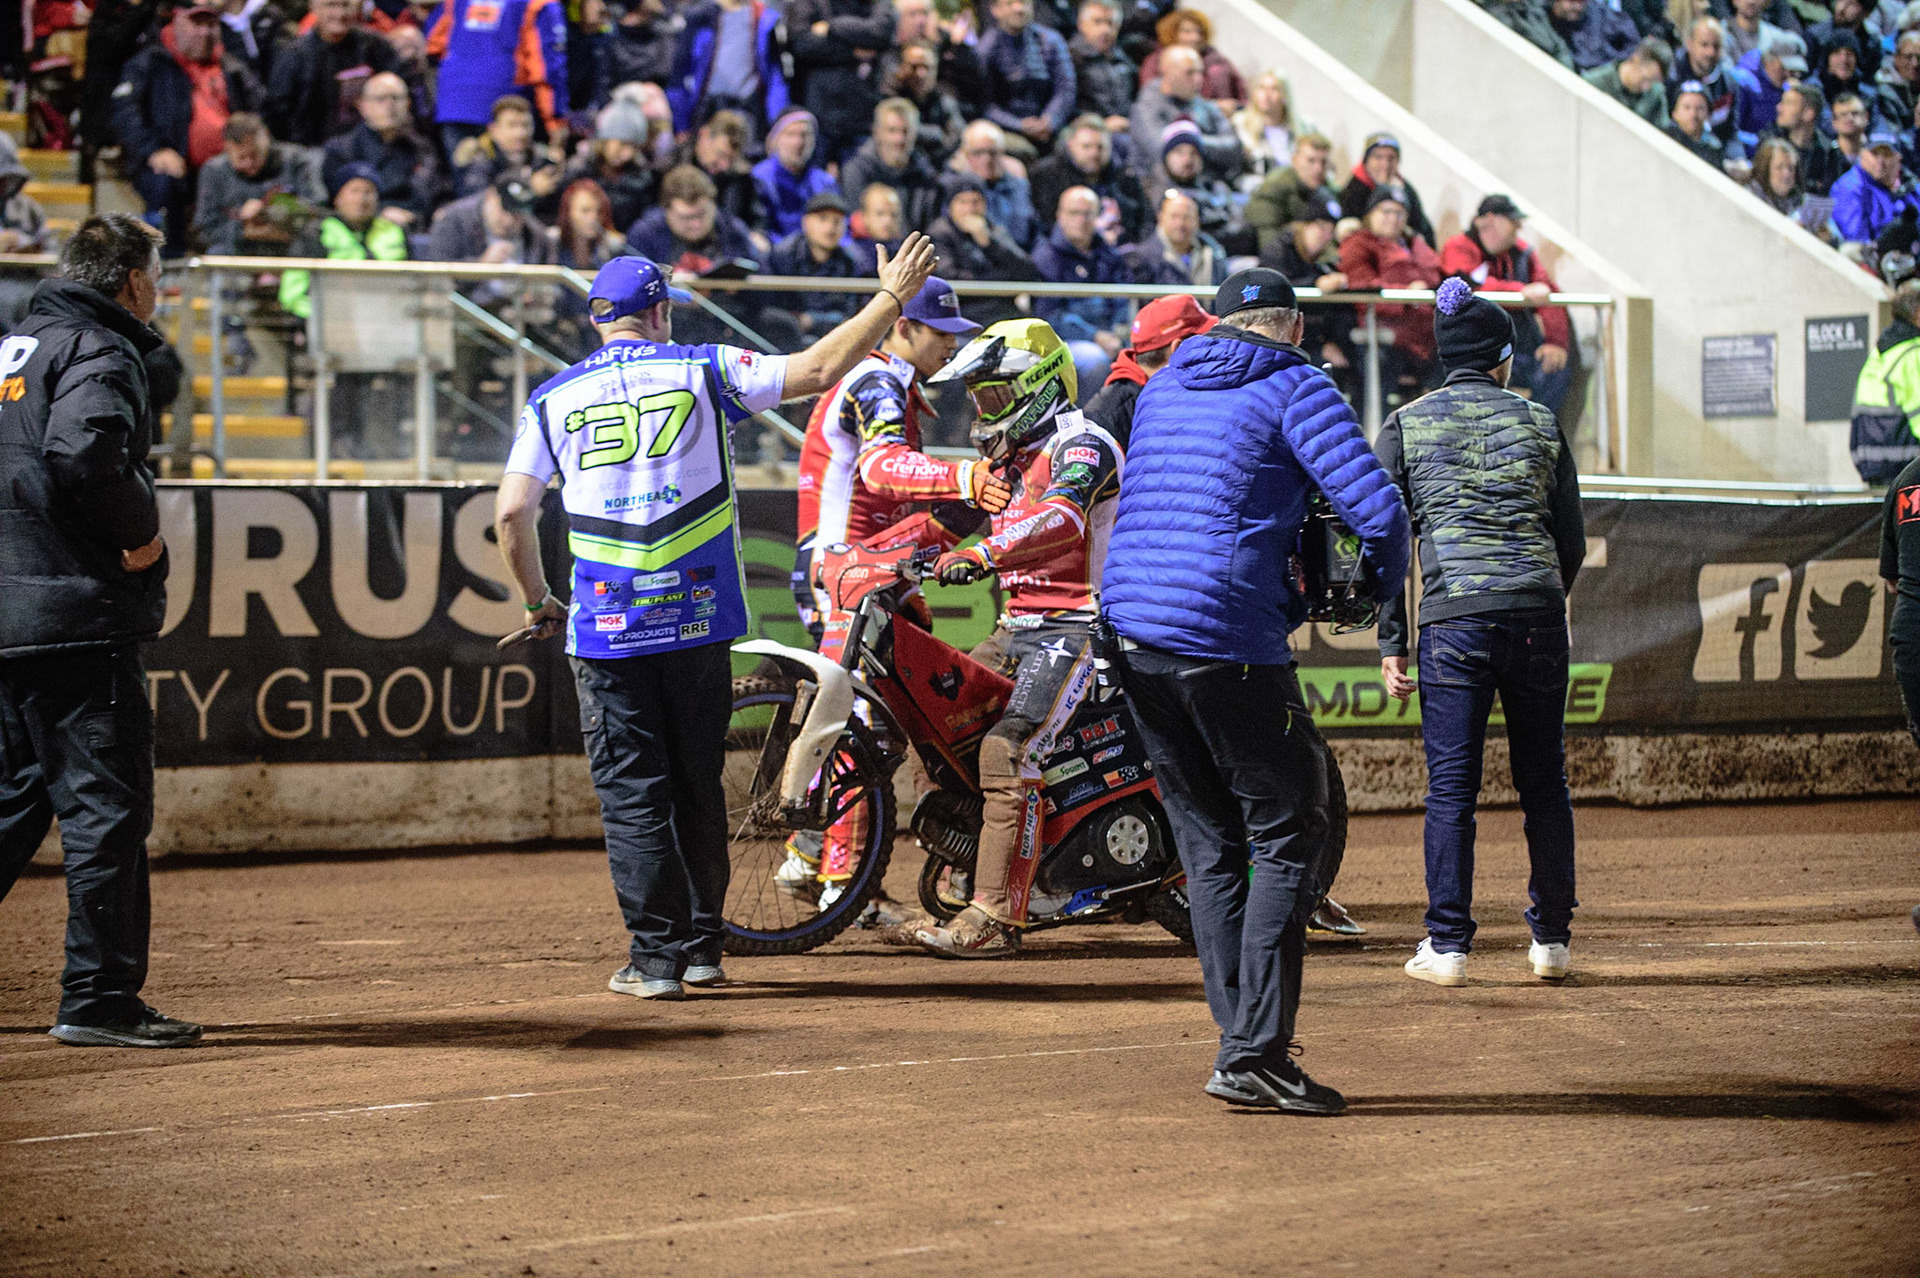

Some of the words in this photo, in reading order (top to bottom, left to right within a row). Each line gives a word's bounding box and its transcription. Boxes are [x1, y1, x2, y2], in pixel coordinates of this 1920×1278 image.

[1025, 354, 1064, 386] KENNY
[1009, 380, 1060, 440] HARRIS
[1067, 449, 1098, 462] NGK
[881, 458, 949, 475] Crendon
[597, 615, 623, 626] NGK
[681, 621, 709, 636] RRE
[624, 626, 676, 642] PRODUCTS
[1030, 650, 1046, 675] CITY
[255, 664, 537, 741] GROUP
[1060, 762, 1087, 776] SPRINT
